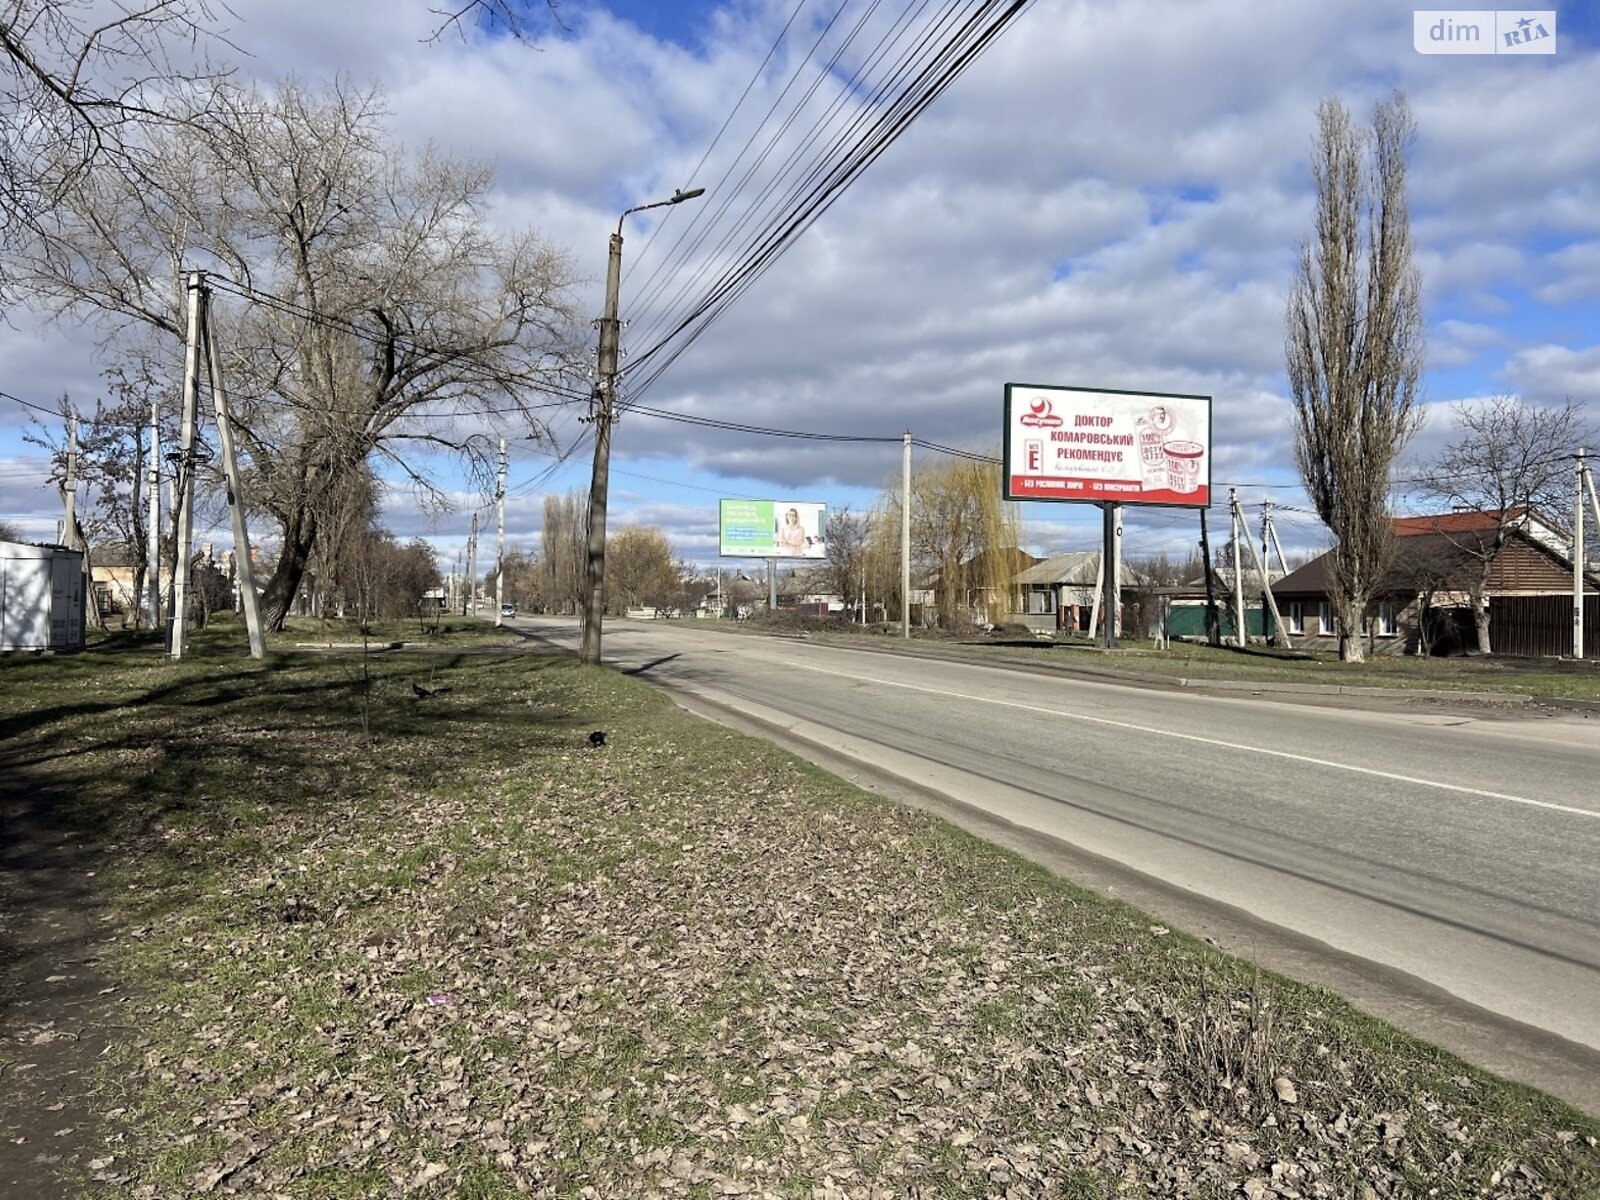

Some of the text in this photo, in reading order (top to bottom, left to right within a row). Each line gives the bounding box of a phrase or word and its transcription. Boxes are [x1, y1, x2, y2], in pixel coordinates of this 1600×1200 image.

[1074, 414, 1113, 428] ДОКТОР
[1050, 431, 1134, 446] КОМАРОВСЬКИЙ
[1057, 447, 1123, 463] РЕКОМЕНДУЄ
